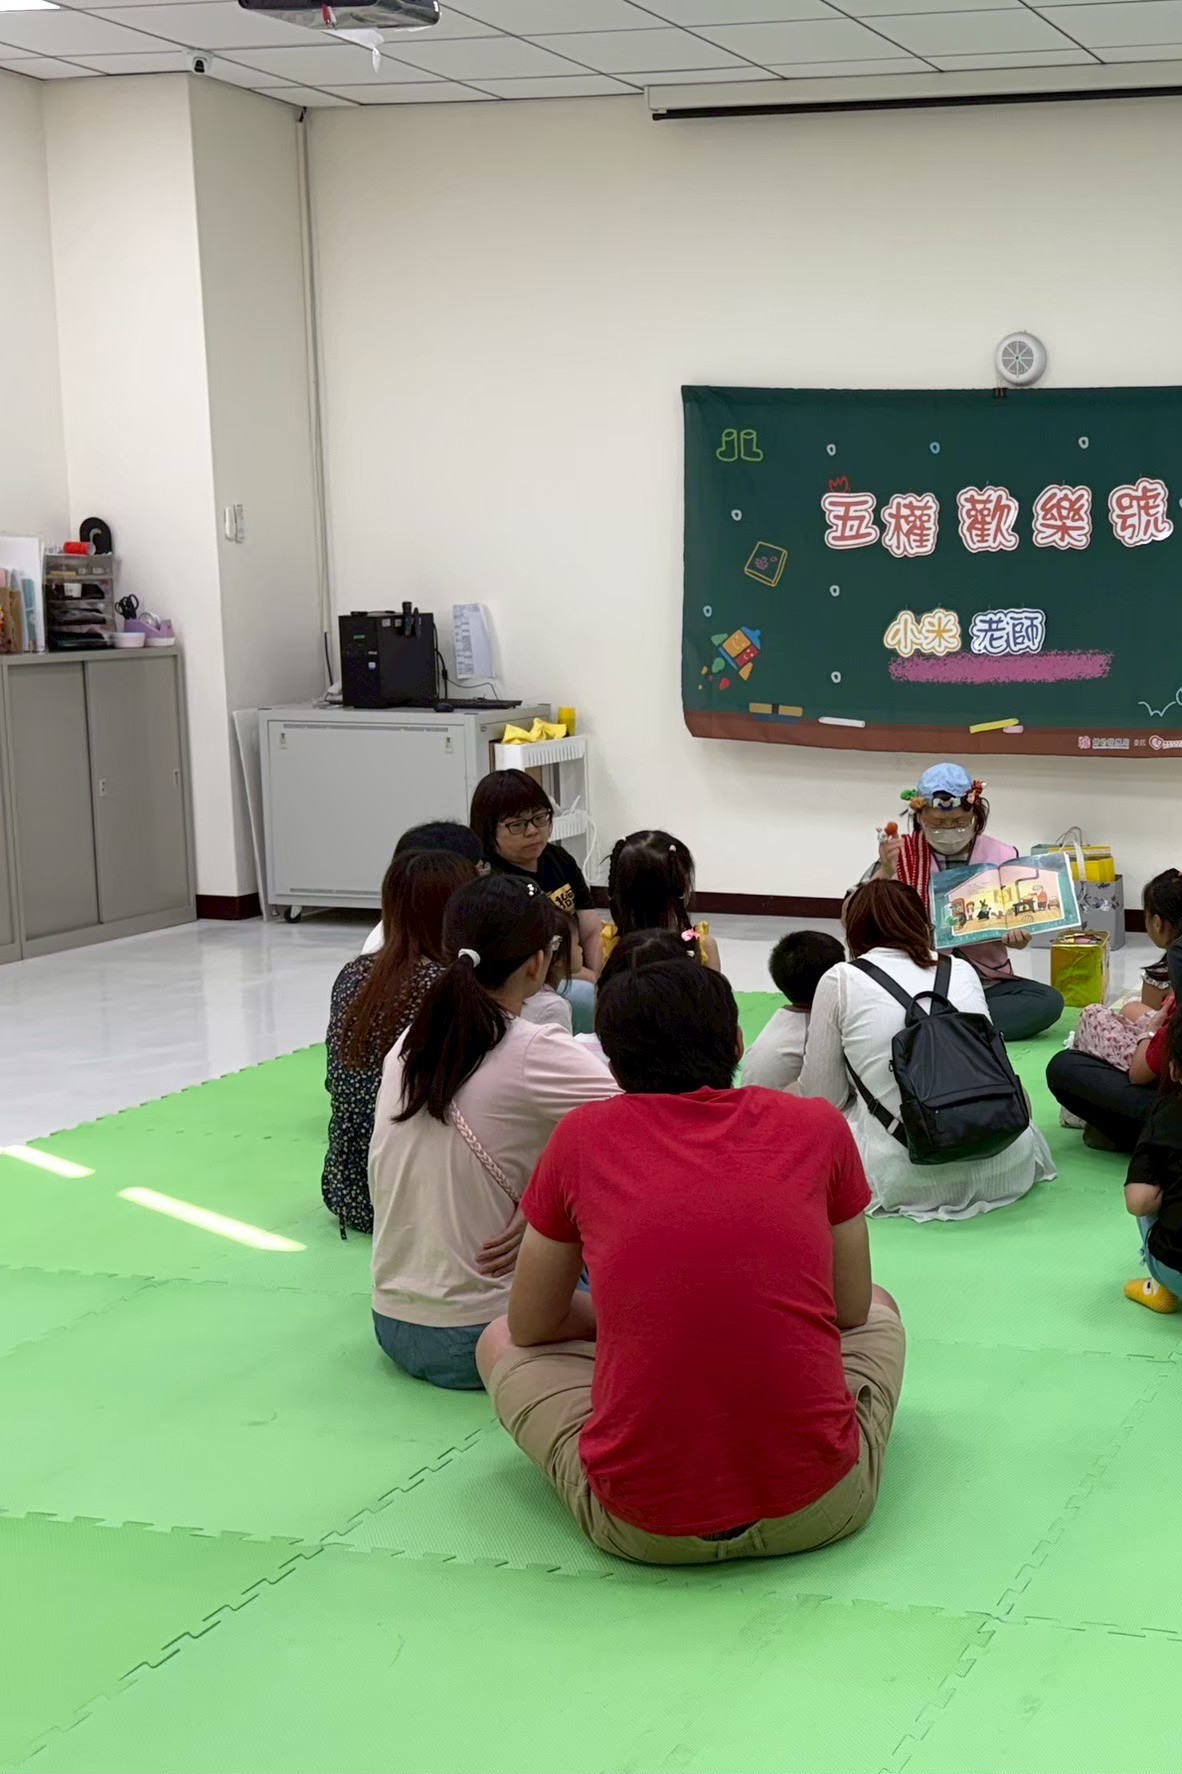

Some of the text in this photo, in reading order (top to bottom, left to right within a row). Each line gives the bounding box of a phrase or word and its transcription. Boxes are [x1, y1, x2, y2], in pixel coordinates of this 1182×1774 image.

[821, 478, 1174, 557] 五權歡樂號
